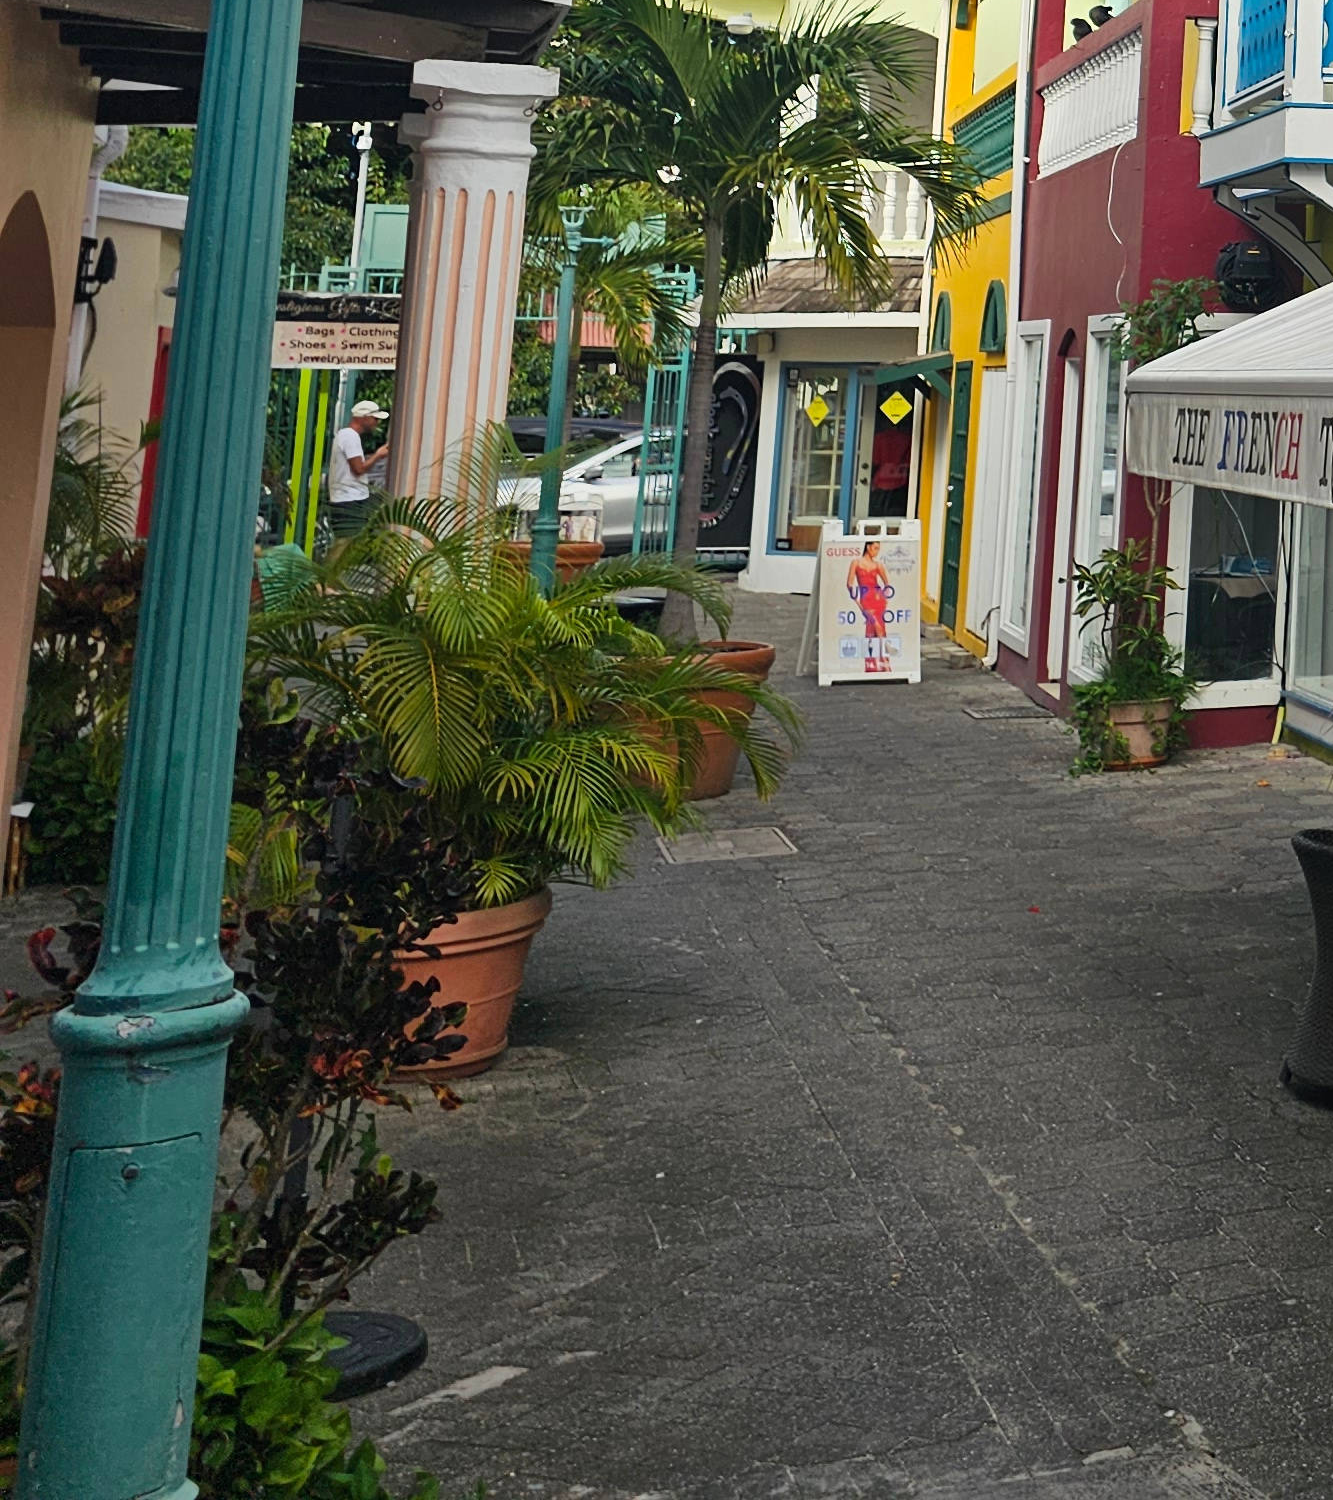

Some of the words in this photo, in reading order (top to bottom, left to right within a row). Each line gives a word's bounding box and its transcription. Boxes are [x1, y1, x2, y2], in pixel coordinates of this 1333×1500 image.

[305, 326, 335, 337] Bags
[349, 326, 400, 339] Clothing
[289, 340, 327, 350] Shoes
[341, 340, 375, 350] Swim
[378, 341, 397, 350] Sui
[371, 355, 396, 364] mor
[1172, 408, 1210, 466] THE
[1217, 410, 1303, 480] FRENCH
[826, 547, 861, 557] GUESS
[849, 586, 869, 600] UP
[875, 585, 895, 599] TO
[838, 611, 856, 624] 50
[882, 610, 911, 623] OFF
